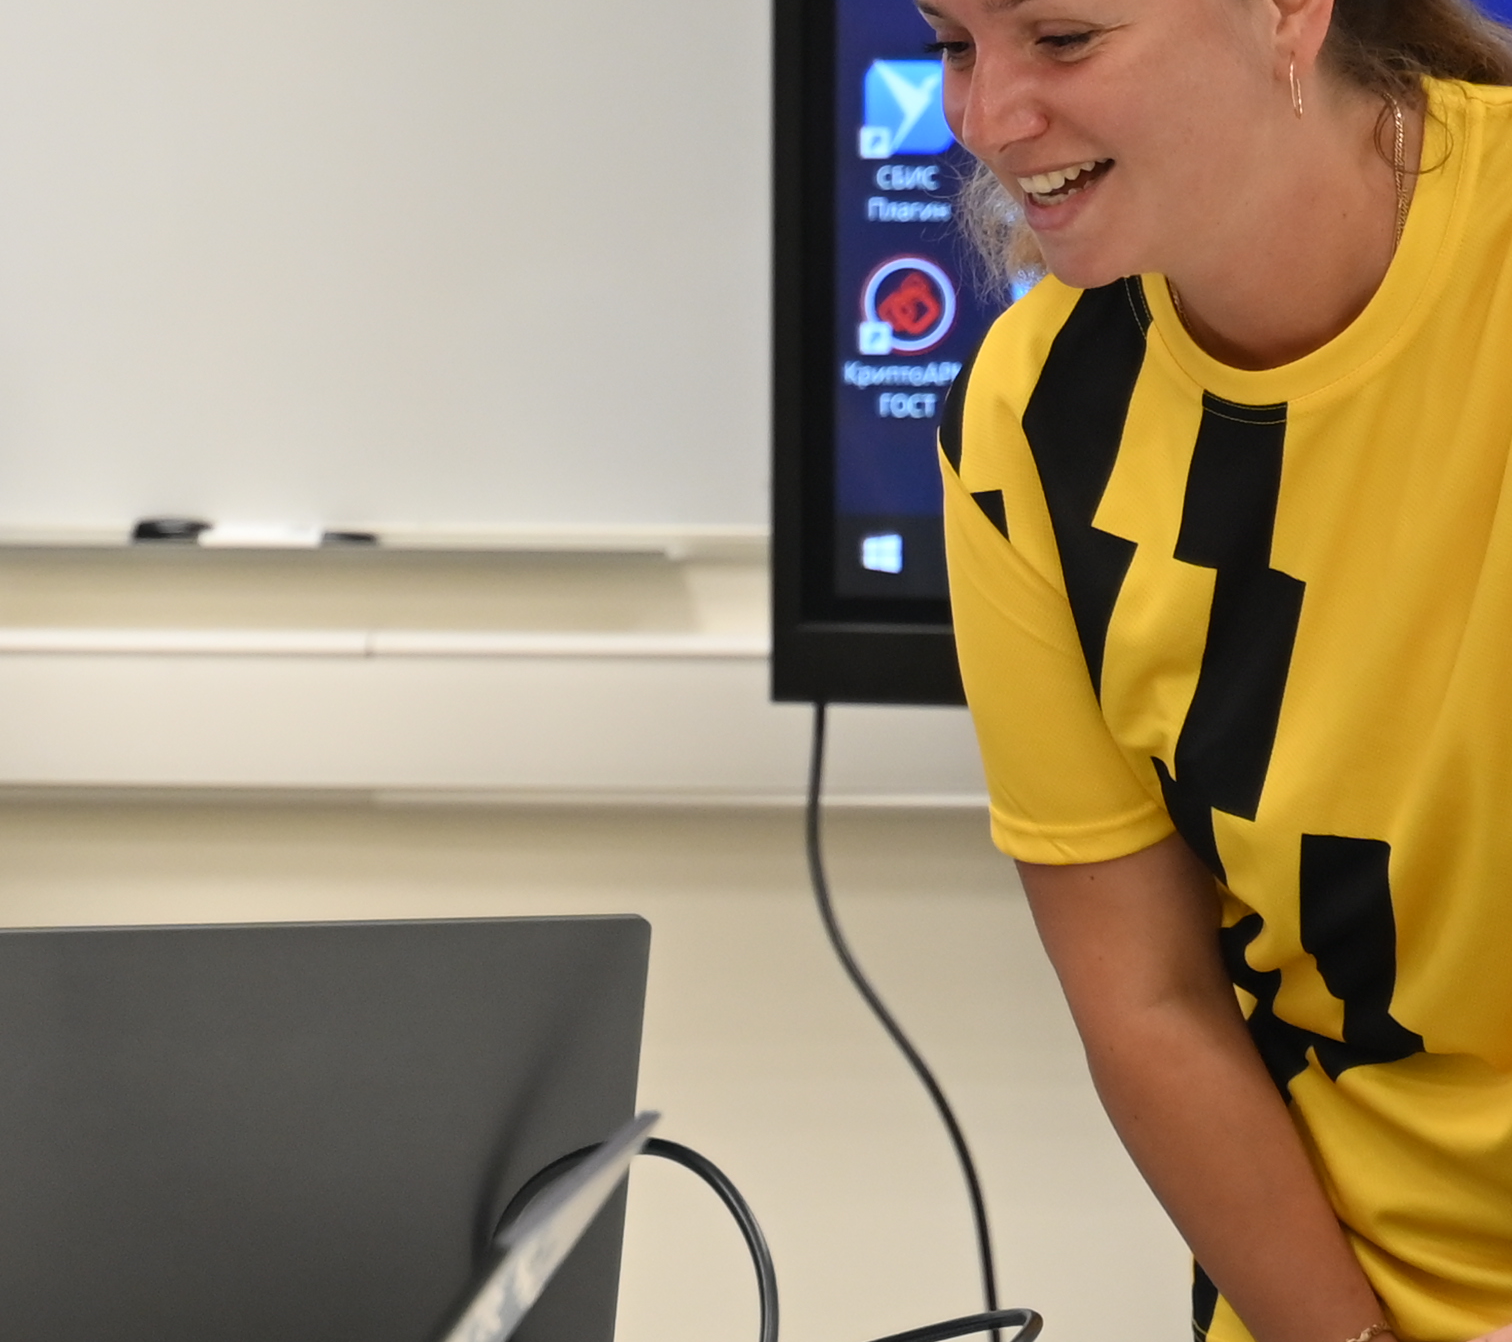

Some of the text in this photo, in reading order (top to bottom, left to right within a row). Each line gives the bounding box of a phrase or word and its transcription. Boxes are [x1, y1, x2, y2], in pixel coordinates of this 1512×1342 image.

[875, 164, 939, 191] СБИС
[866, 196, 952, 223] Плагин
[878, 392, 937, 419] ГОСТ
